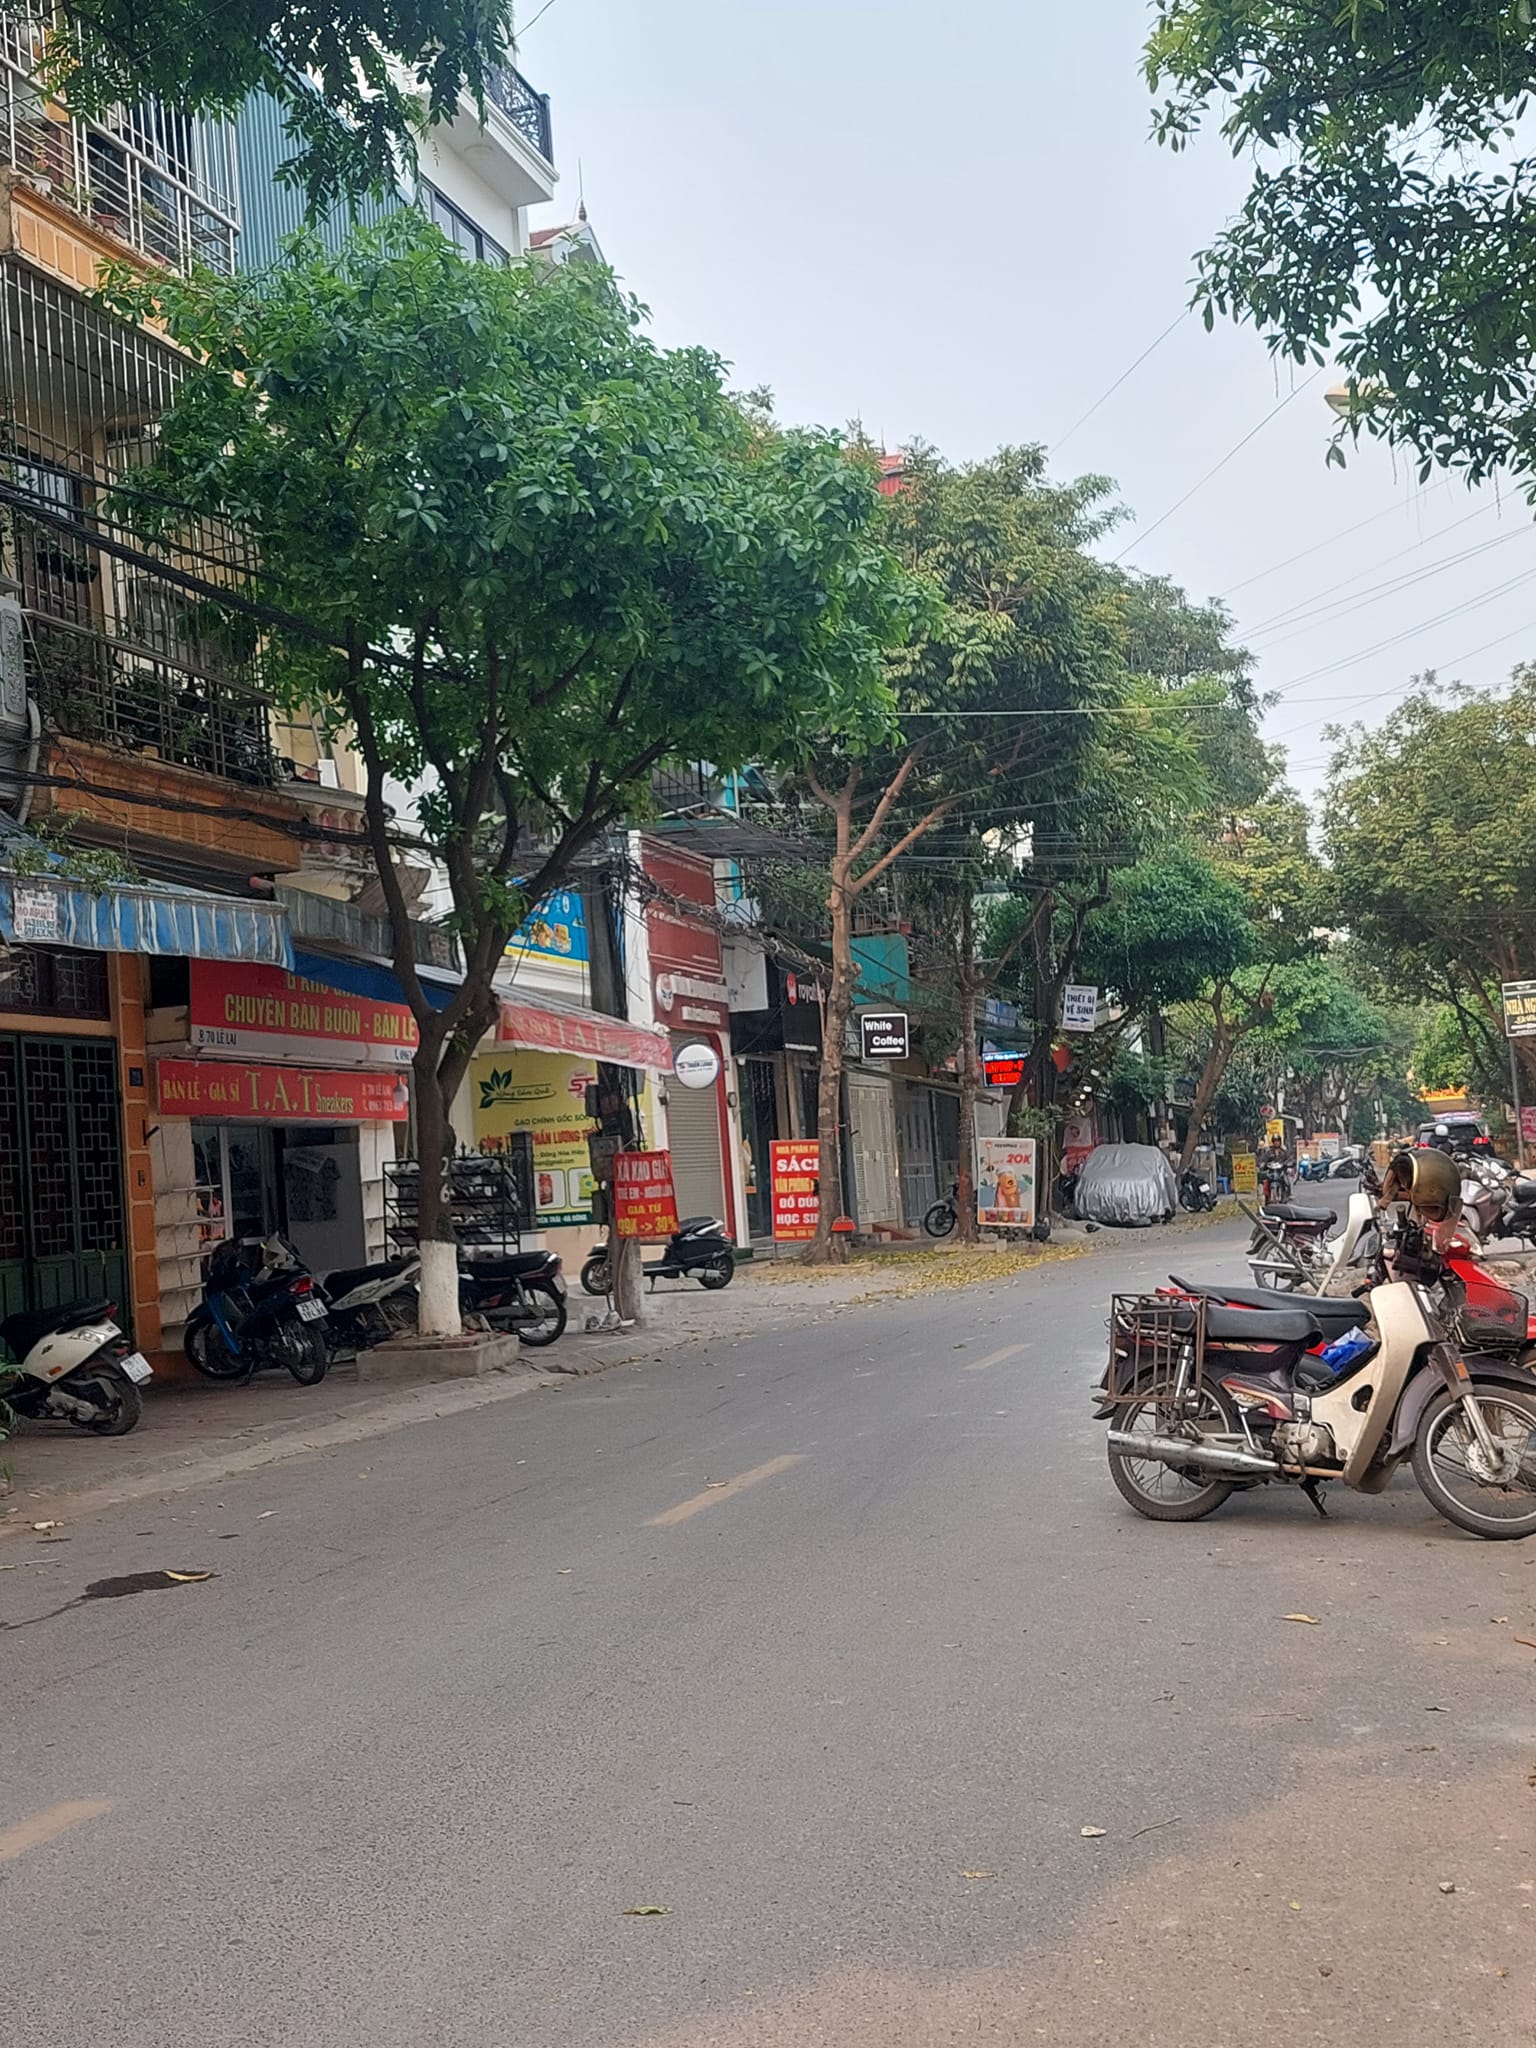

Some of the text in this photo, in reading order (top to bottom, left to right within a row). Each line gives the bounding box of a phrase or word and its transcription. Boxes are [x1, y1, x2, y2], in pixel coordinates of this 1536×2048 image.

[1067, 993, 1086, 1004] THIẾT
[1505, 994, 1524, 1016] NHÀ
[224, 994, 285, 1027] CHUYÊN
[324, 1003, 361, 1036] BUÔN
[1076, 1005, 1094, 1015] SINH
[864, 1020, 893, 1031] White
[872, 1035, 905, 1046] Coffee
[245, 1071, 313, 1114] T.A.T
[315, 1084, 354, 1113] Sneakers
[1007, 1153, 1031, 1164] 20K
[798, 1194, 819, 1208] DÙN
[617, 1218, 637, 1235] 99K
[776, 1213, 800, 1227] HỌC
